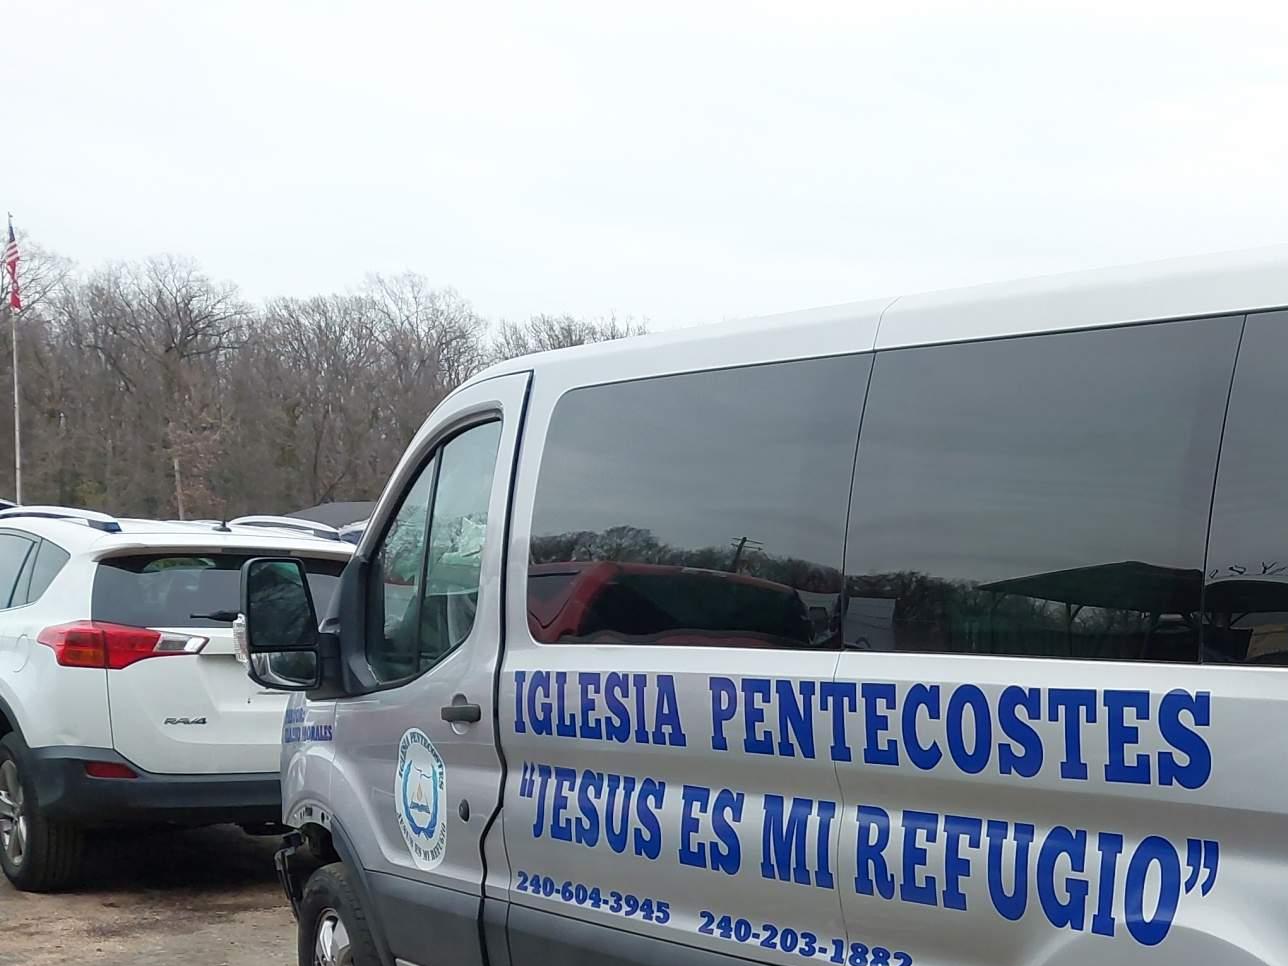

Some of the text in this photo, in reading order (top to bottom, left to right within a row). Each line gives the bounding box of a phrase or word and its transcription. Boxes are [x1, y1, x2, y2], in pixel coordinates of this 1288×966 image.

[163, 716, 207, 725] RAV4
[513, 670, 1213, 790] IGLESIA PENTECOSTES
[679, 784, 745, 875] ES
[760, 793, 837, 890] MI
[515, 870, 671, 925] 240-604-3945
